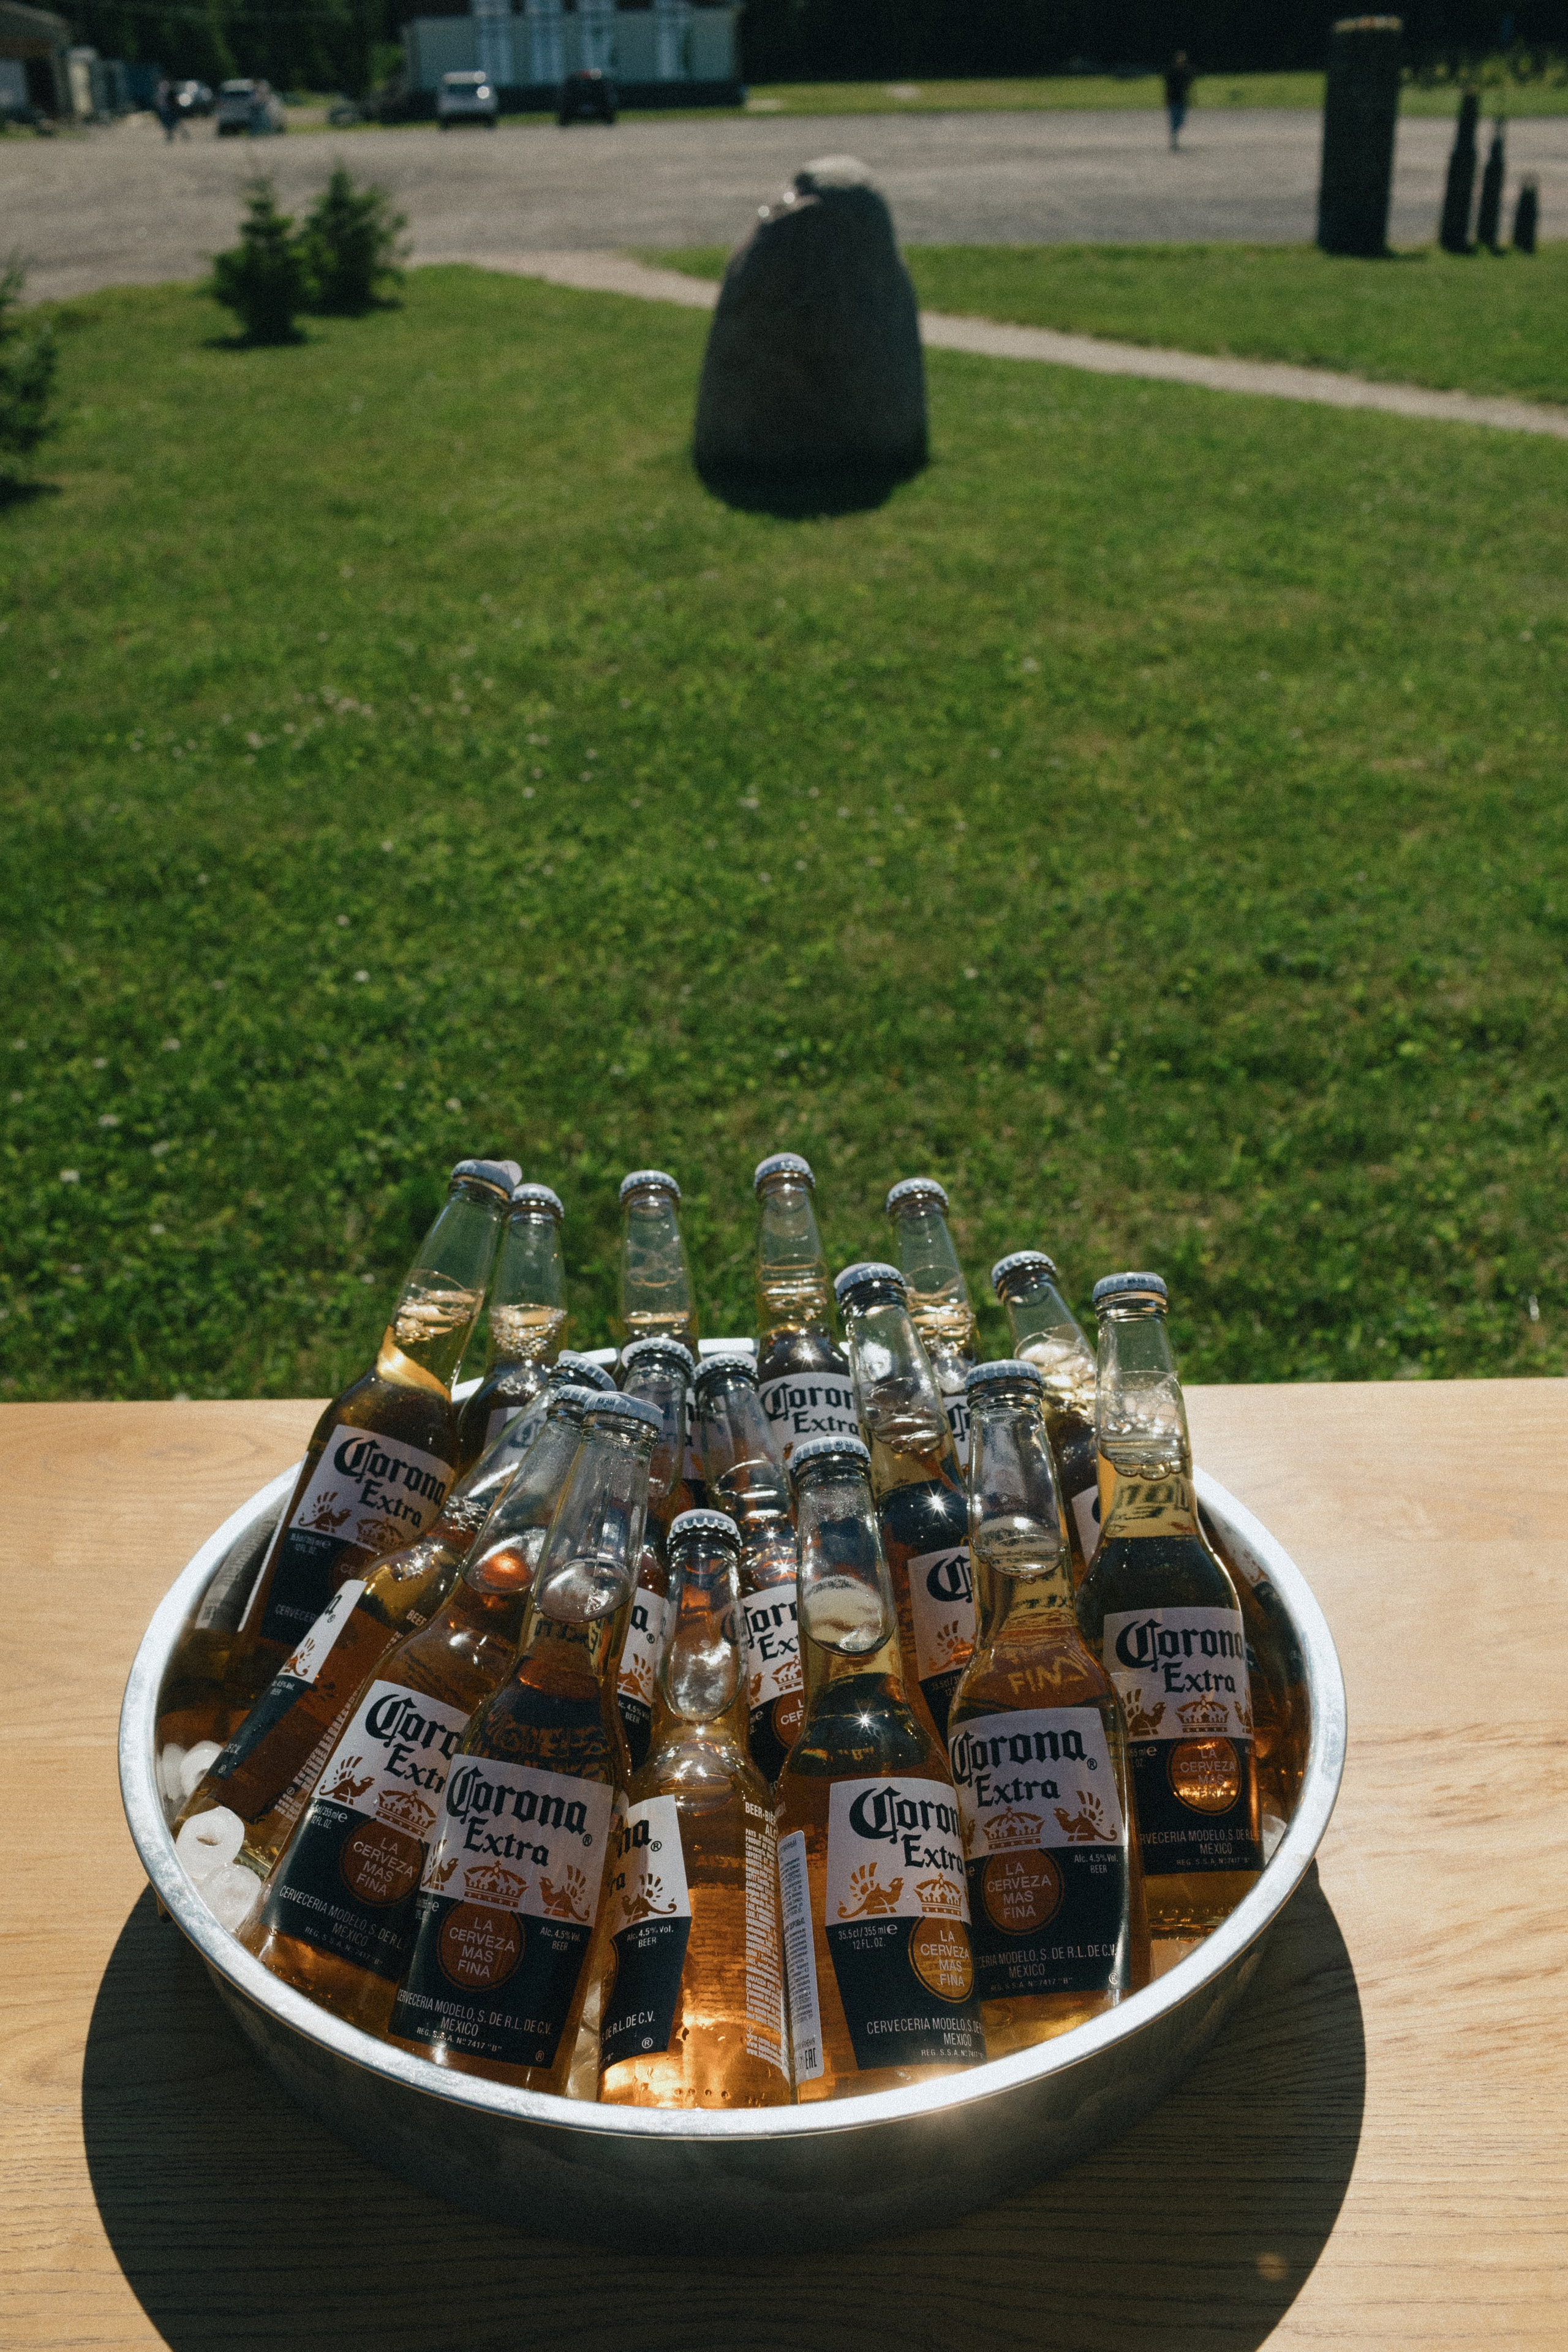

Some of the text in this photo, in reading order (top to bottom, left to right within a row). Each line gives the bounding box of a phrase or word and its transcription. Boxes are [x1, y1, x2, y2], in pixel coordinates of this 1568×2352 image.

[760, 1382, 854, 1420] Coron
[333, 1437, 447, 1506] Corona
[358, 1479, 421, 1528] Extra
[1164, 1661, 1236, 1694] Extra
[365, 1694, 462, 1760] Coro
[951, 1728, 1087, 1785] Corona
[1200, 1749, 1217, 1759] LA
[383, 1743, 446, 1793] Extr
[1180, 1760, 1236, 1773] CERVEZA
[976, 1774, 1060, 1809] Extra
[447, 1766, 587, 1836] Corona
[381, 1838, 398, 1855] LA
[463, 1815, 549, 1866] Extra
[1199, 1842, 1233, 1855] MEXICO
[353, 1841, 414, 1878] CERVEZA
[901, 1834, 964, 1876] Extra
[1074, 1854, 1088, 1863] Alc.
[363, 1860, 393, 1883] MAS
[1005, 1862, 1025, 1875] LA
[1090, 1864, 1107, 1874] BEER
[356, 1873, 387, 1896] FINA
[987, 1874, 1052, 1893] CERVEZA
[279, 1885, 328, 1913] CERVECERIA
[1003, 1890, 1035, 1905] MAS
[1003, 1905, 1036, 1919] FINA
[473, 1917, 493, 1932] LA
[540, 1926, 553, 1937] Alc.
[639, 1927, 658, 1938] 4.5%
[659, 1924, 674, 1934] Vol.
[331, 1922, 368, 1947] MEXICO
[448, 1926, 516, 1953] CERVEZA
[638, 1936, 657, 1948] BEER
[940, 1929, 956, 1943] LA
[461, 1945, 494, 1962] MAS
[552, 1941, 568, 1951] BEER
[920, 1943, 970, 1959] CERVEZA
[1052, 1947, 1065, 1959] DE
[1088, 1945, 1100, 1957] DE
[457, 1959, 490, 1978] FINA
[938, 1959, 963, 1972] MAS
[1009, 1963, 1046, 1978] MEXICO
[940, 1973, 965, 1987] FINA
[397, 1988, 433, 2011] CERVECERIA
[489, 2011, 503, 2026] DE
[524, 2019, 537, 2033] DE
[626, 2014, 637, 2028] DE
[638, 2010, 655, 2024] C.V.
[440, 2016, 479, 2037] MEXICO
[866, 2018, 931, 2035] CERVECERIA
[417, 2027, 431, 2037] REG.
[467, 2038, 486, 2049] 7417
[943, 2032, 972, 2047] MEXICO
[921, 2048, 937, 2057] REG.
